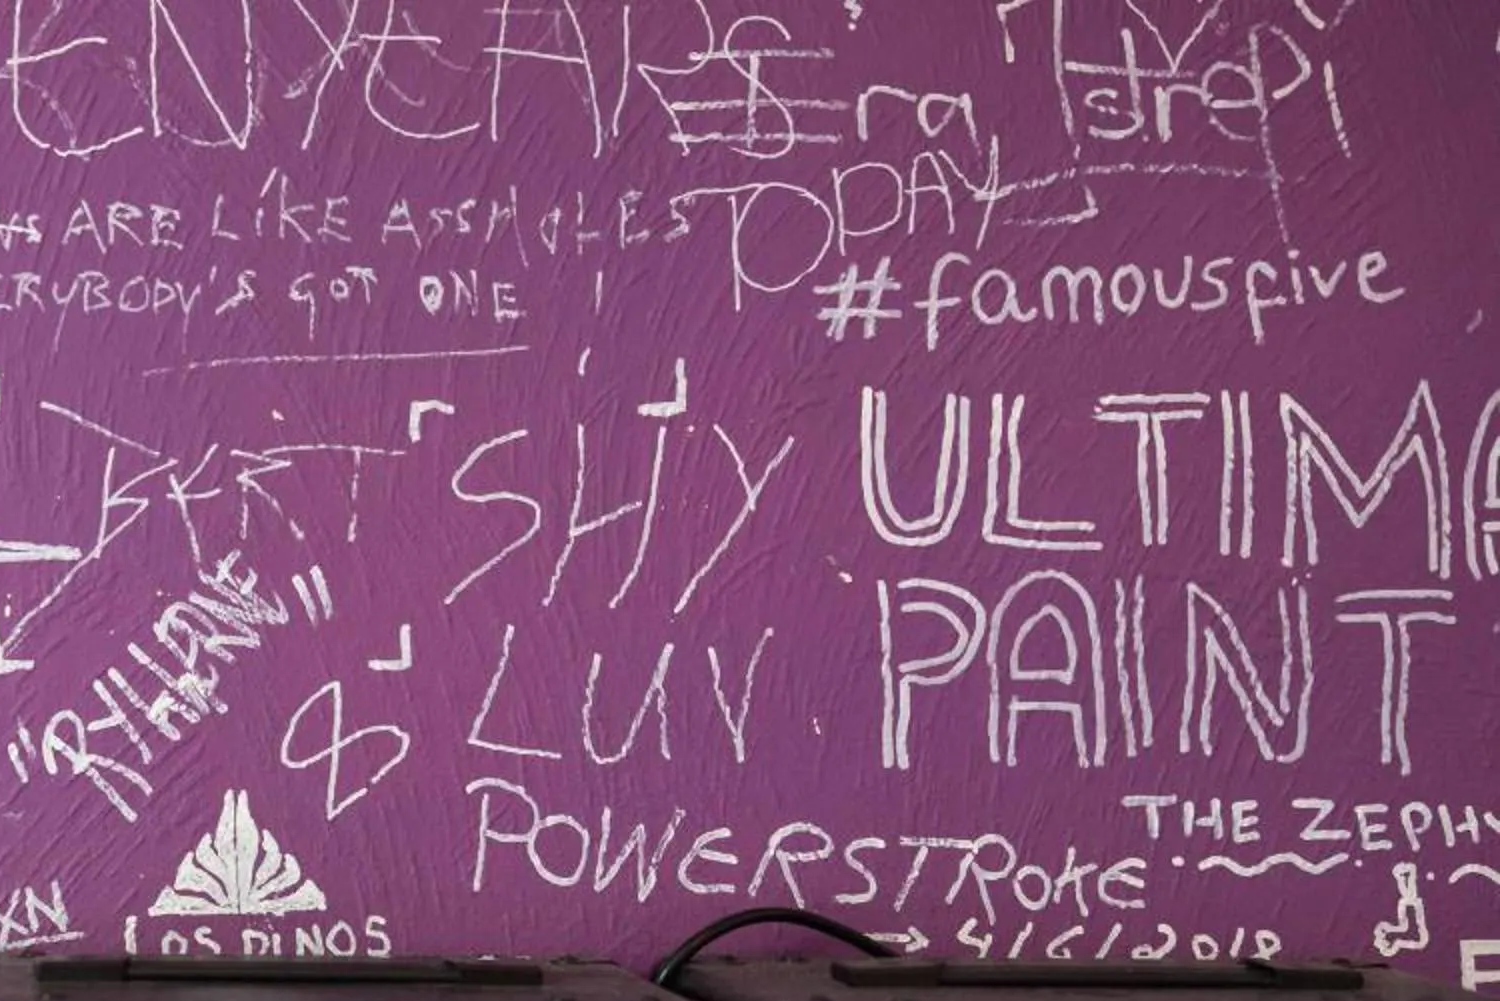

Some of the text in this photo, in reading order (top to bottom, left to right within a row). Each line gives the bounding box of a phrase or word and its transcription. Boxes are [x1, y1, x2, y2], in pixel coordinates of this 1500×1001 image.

[62, 198, 183, 254] ARE
[289, 266, 377, 339] GOT
[419, 269, 527, 318] ONE
[814, 247, 1405, 350] #famousfive
[444, 424, 794, 613] SHY
[467, 624, 773, 764] LUV
[876, 569, 1457, 775] PAINT
[466, 778, 1148, 925] POWERSTROKE
[1122, 795, 1261, 844] THE
